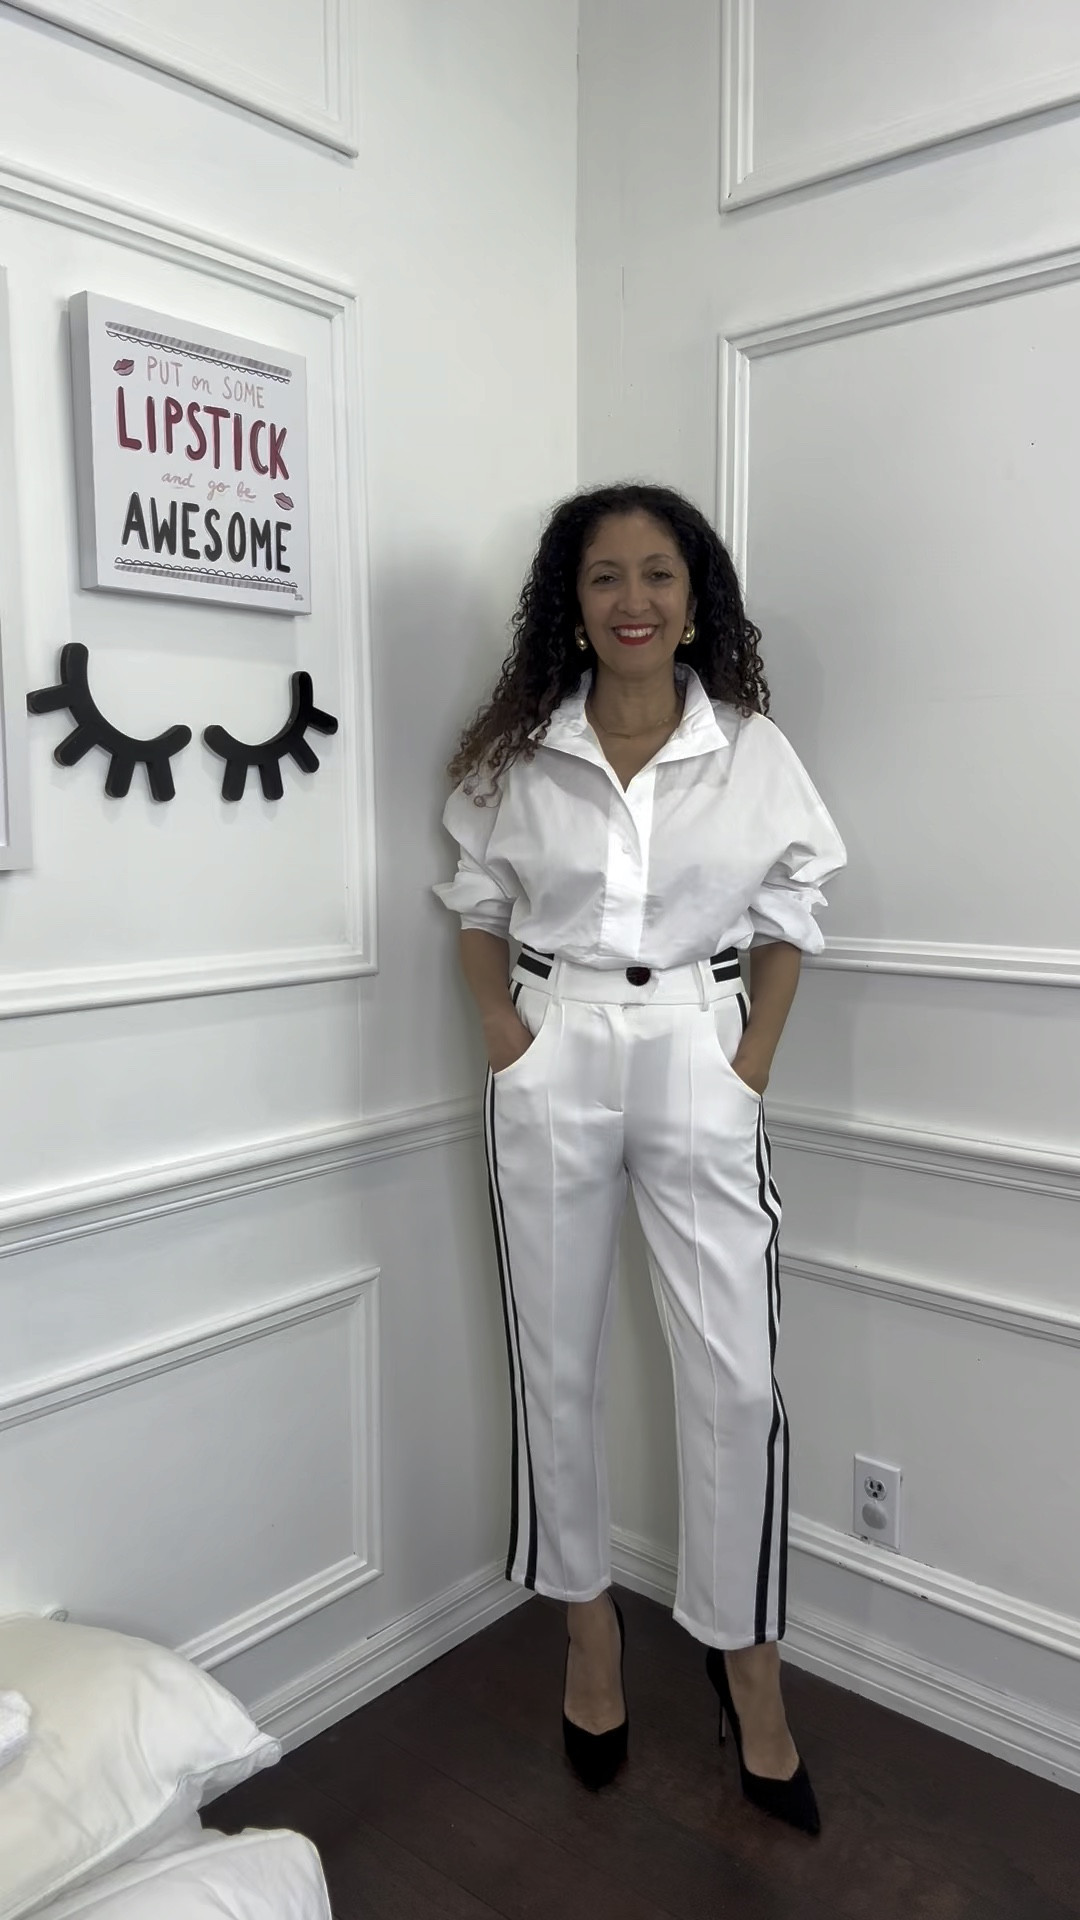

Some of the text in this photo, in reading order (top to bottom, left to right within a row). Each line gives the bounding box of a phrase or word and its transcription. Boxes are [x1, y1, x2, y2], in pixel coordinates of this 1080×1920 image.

[147, 355, 265, 409] PUT on SOME
[116, 385, 290, 480] LIPSTICK
[161, 472, 257, 500] and go be
[121, 491, 292, 573] AWESOME
